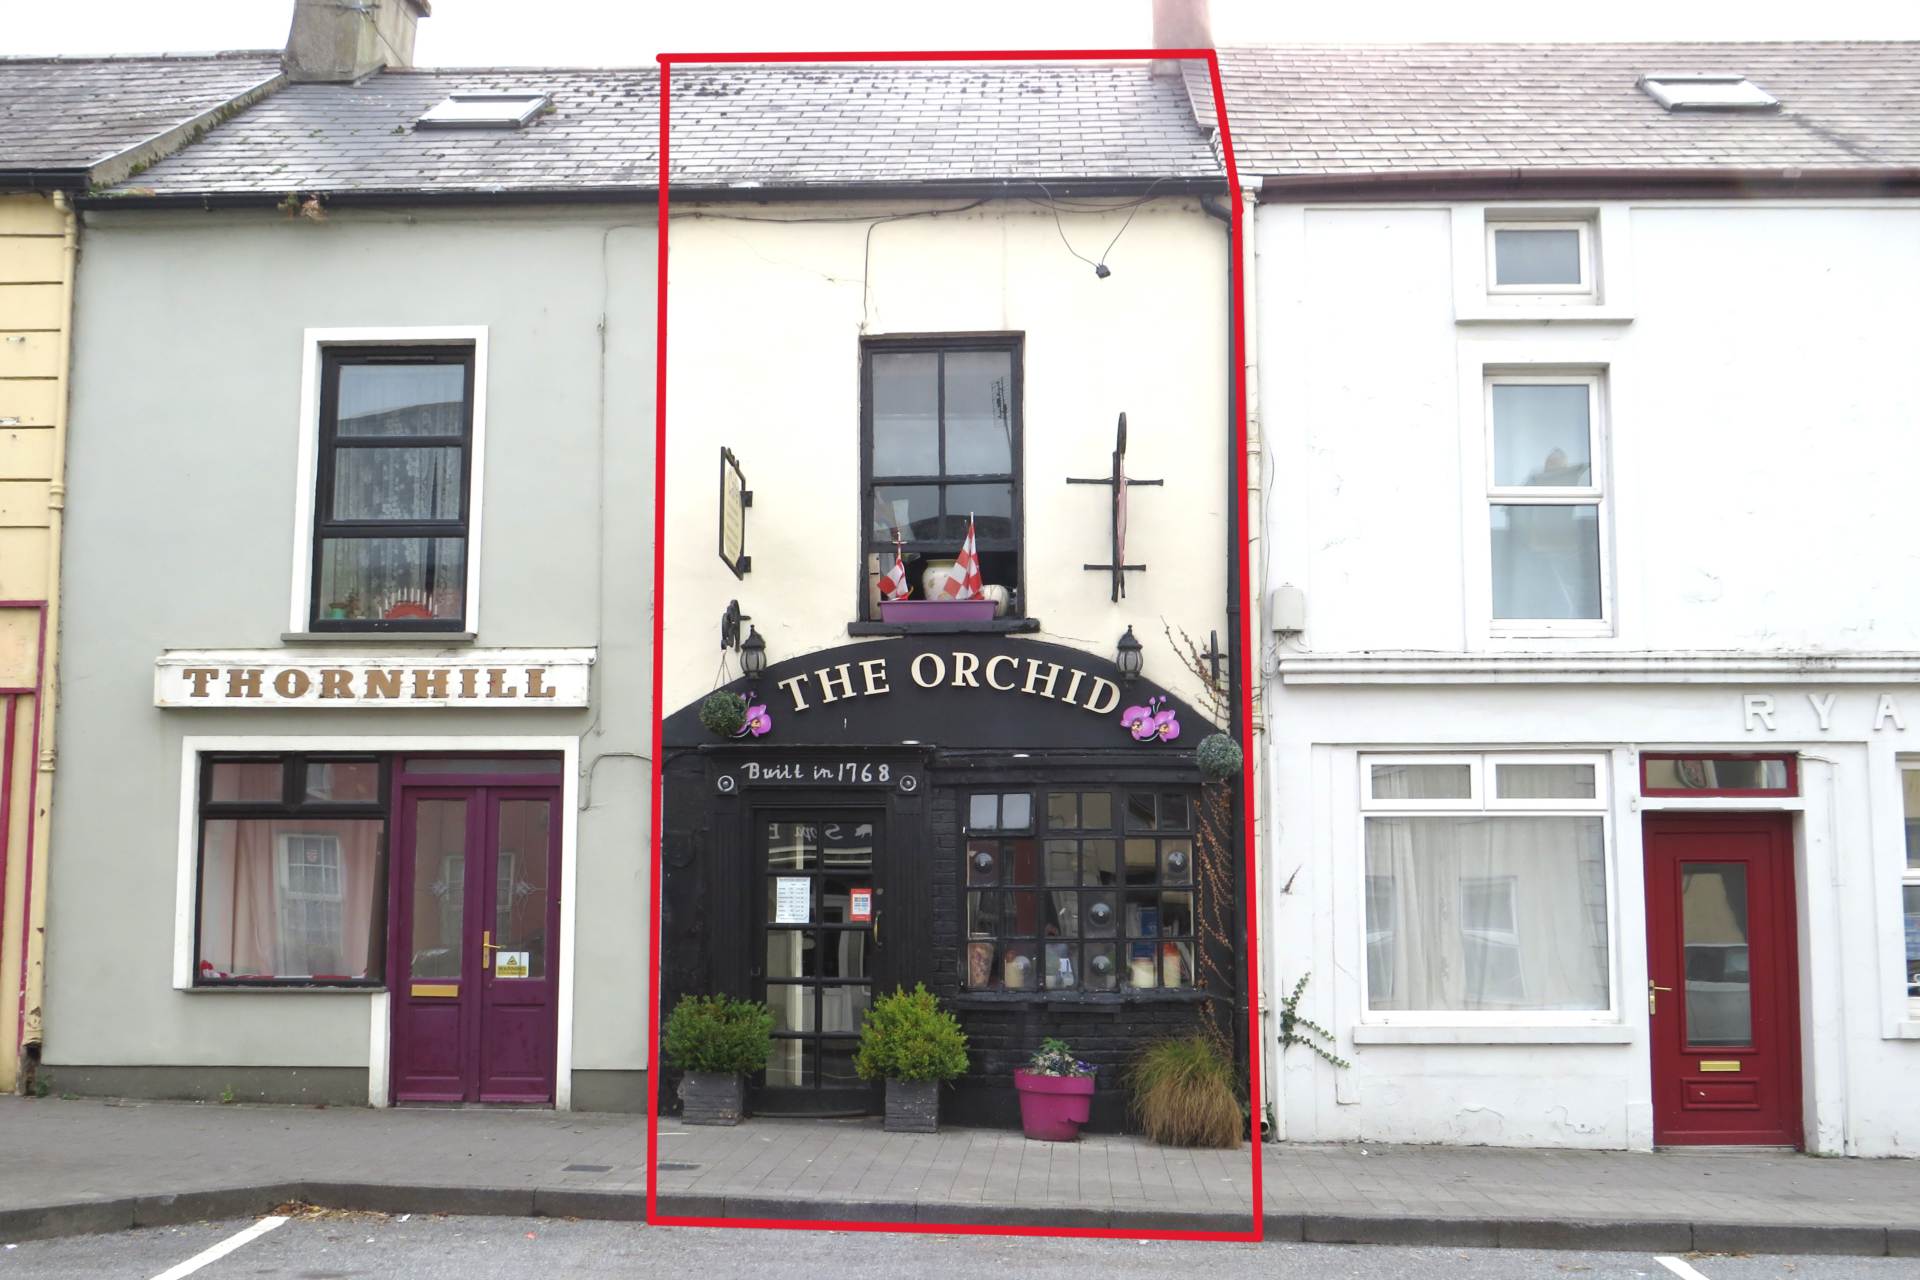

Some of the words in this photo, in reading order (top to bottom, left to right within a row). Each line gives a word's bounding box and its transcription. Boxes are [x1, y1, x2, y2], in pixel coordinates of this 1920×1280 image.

[182, 668, 556, 699] THORNHILL
[777, 658, 890, 712] THE
[910, 651, 1121, 714] ORCHID
[1743, 693, 1906, 732] RYA
[740, 762, 804, 780] Built
[813, 765, 834, 780] in
[838, 762, 890, 783] 1768
